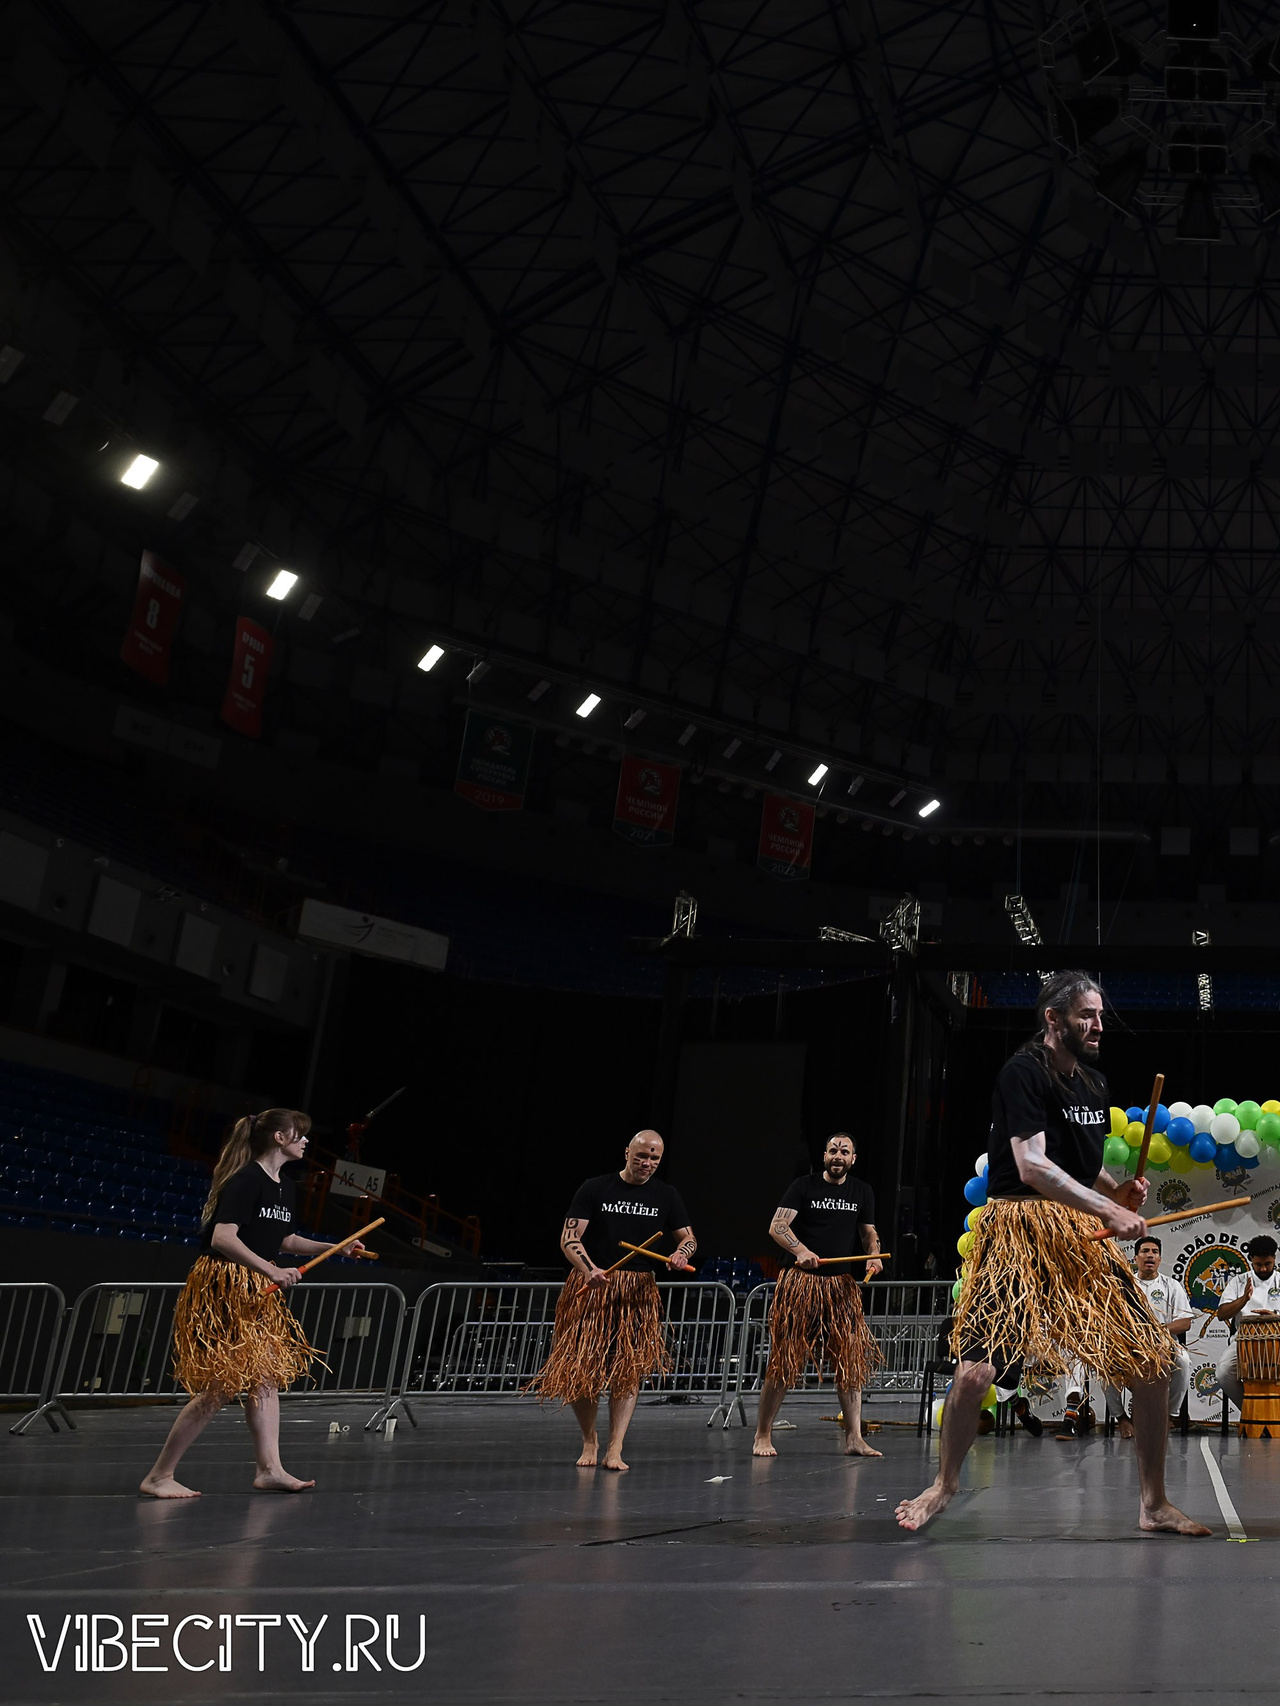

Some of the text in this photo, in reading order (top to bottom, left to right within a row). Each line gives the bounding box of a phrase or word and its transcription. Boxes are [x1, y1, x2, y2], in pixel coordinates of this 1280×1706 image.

[146, 597, 161, 630] 8
[241, 653, 255, 689] 5
[474, 789, 505, 805] 2019
[625, 795, 669, 813] ЧЕМПИОН
[628, 805, 664, 821] РОССИИ
[629, 827, 656, 842] 2021
[767, 832, 805, 849] ЧЕМПИОН
[770, 841, 801, 856] РОССИИ
[339, 1170, 379, 1192] A6 A5
[1156, 1180, 1168, 1204] CORDÃO
[1177, 1179, 1191, 1194] OURO
[601, 1202, 659, 1217] MACULELE
[811, 1200, 858, 1212] MACULELE
[1267, 1199, 1279, 1222] CORDÃO
[1170, 1213, 1212, 1233] КАЛИНИНГРАД
[1171, 1233, 1216, 1283] CORDÃO
[1219, 1232, 1239, 1246] DE
[1189, 1364, 1202, 1390] CORDÃO
